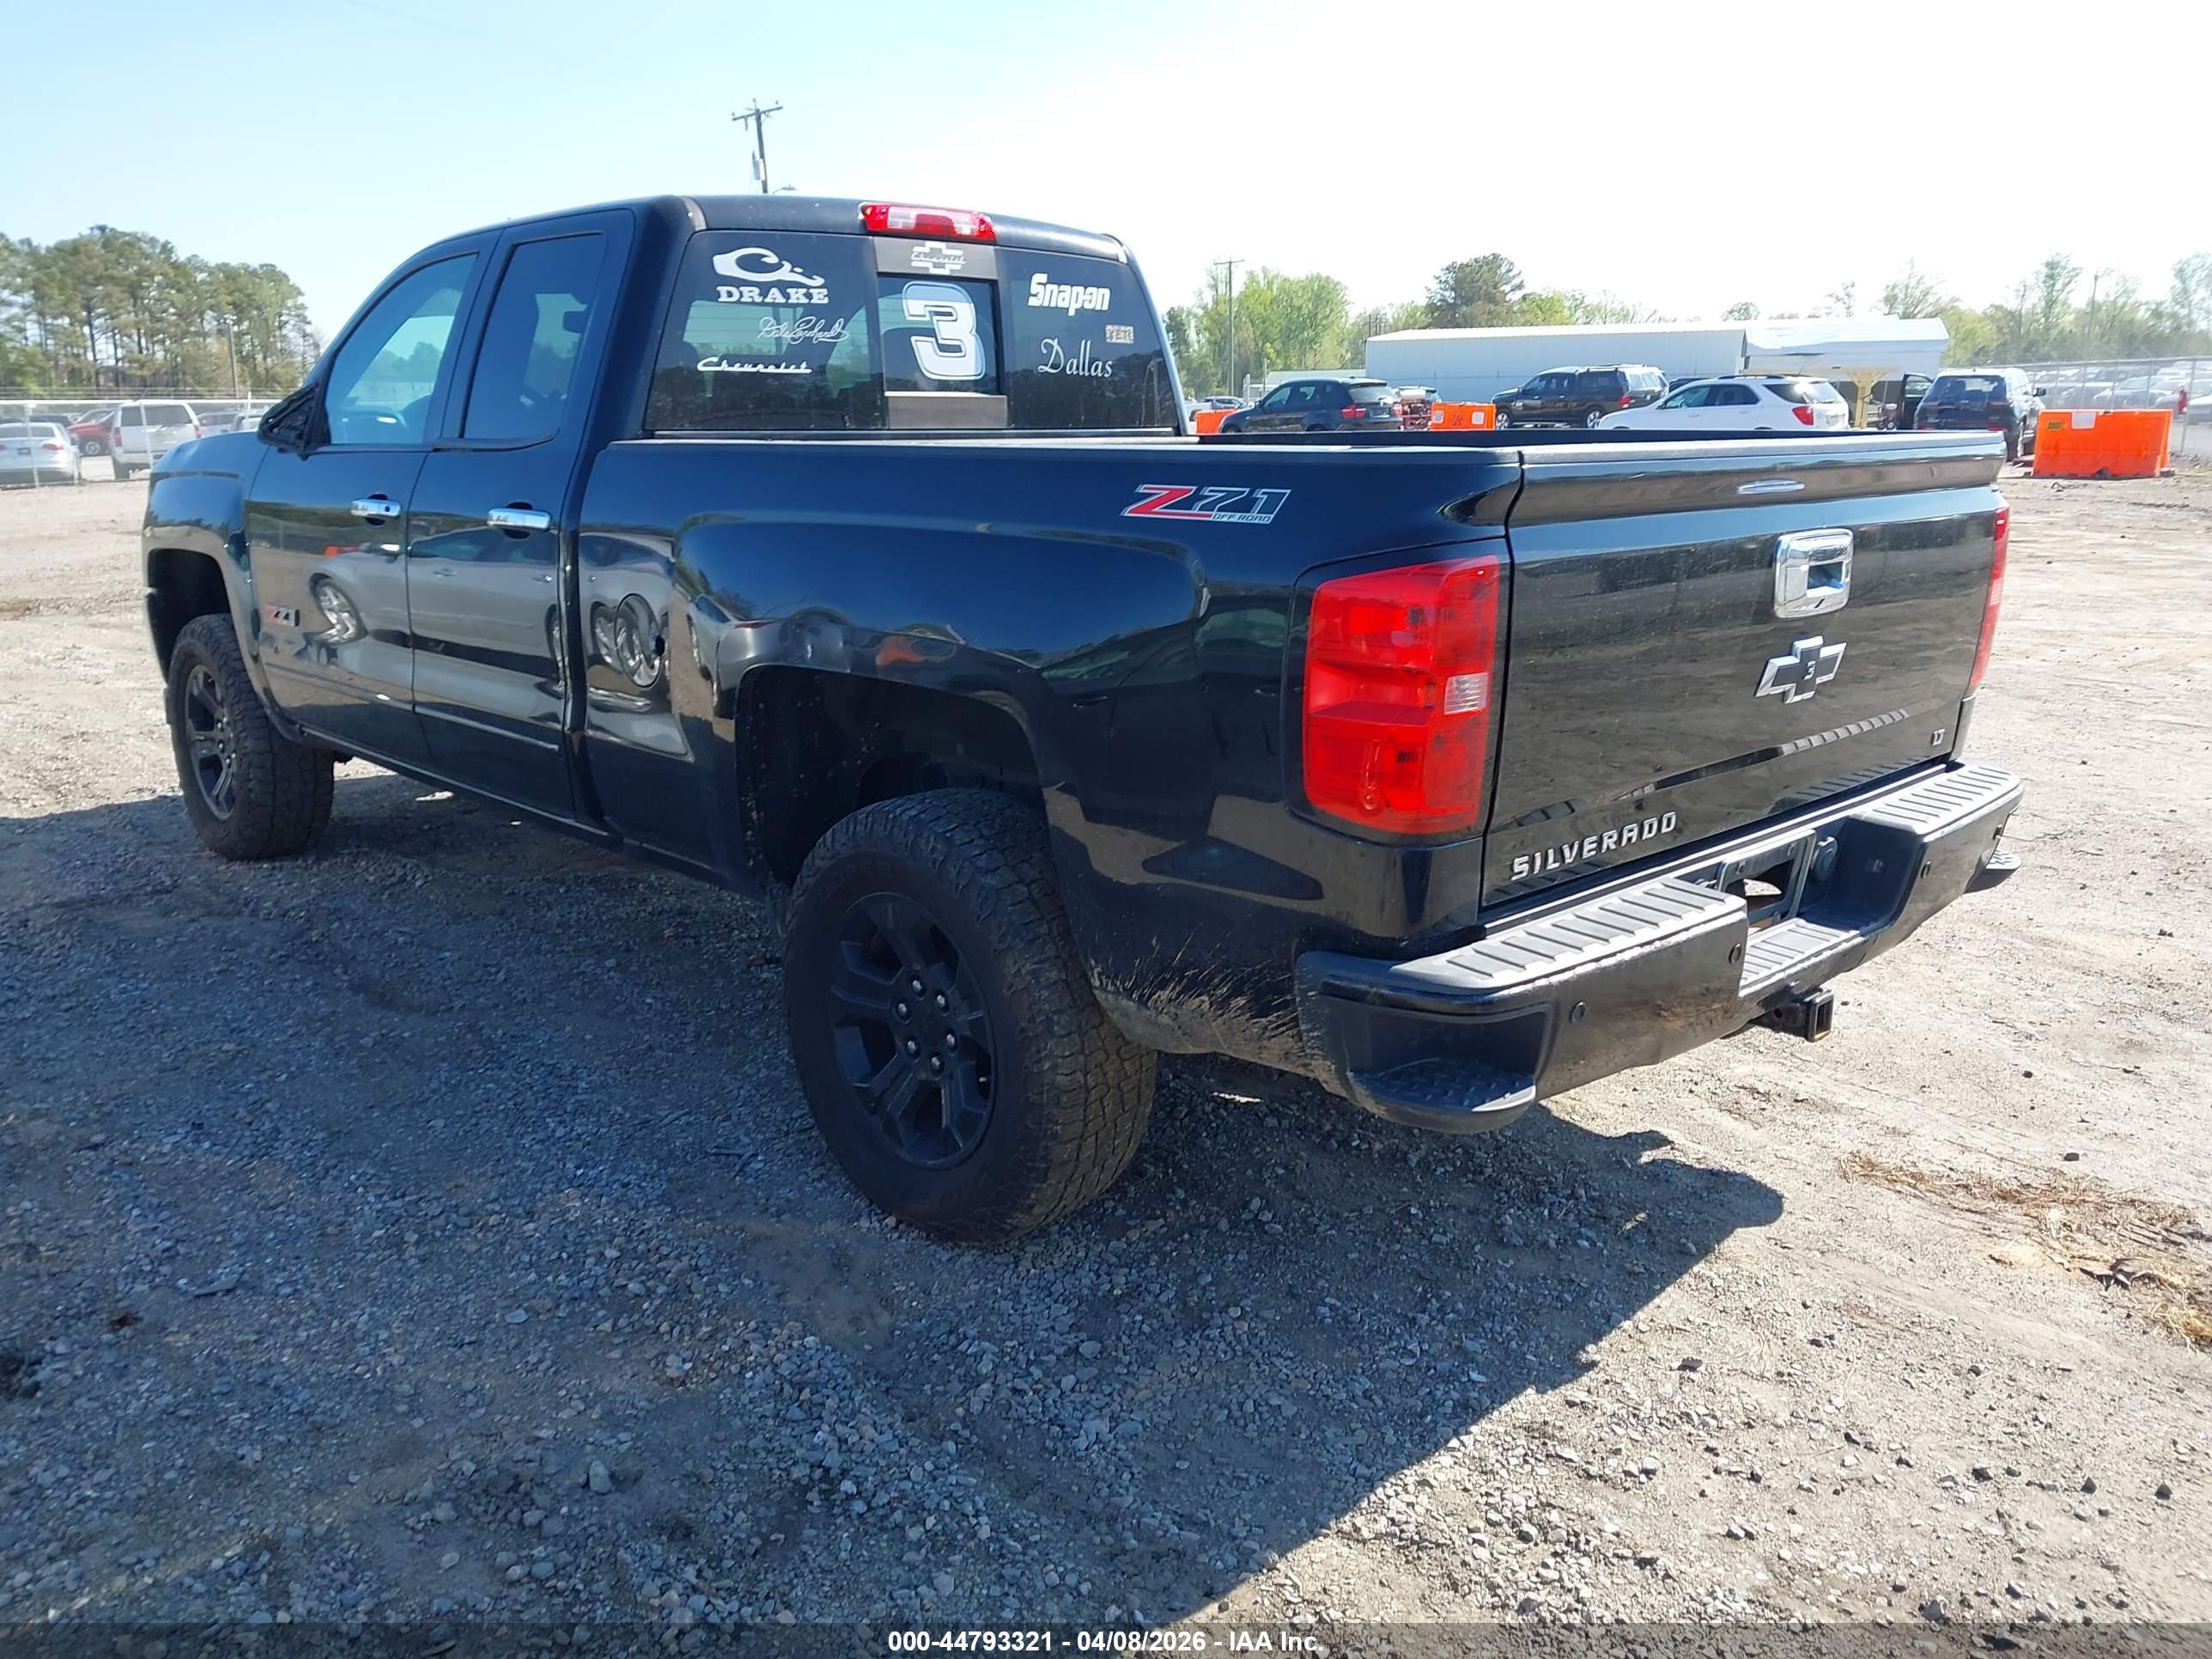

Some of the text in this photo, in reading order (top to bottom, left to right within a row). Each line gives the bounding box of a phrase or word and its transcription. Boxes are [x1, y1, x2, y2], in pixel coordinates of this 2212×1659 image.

[716, 286, 829, 303] DRAKE
[902, 281, 986, 380] 3
[697, 357, 812, 374] Chevrolet
[1037, 337, 1113, 378] Dallas
[1120, 483, 1291, 521] Z71
[1237, 514, 1272, 523] ROAD
[1510, 811, 1676, 881] SILVERADO
